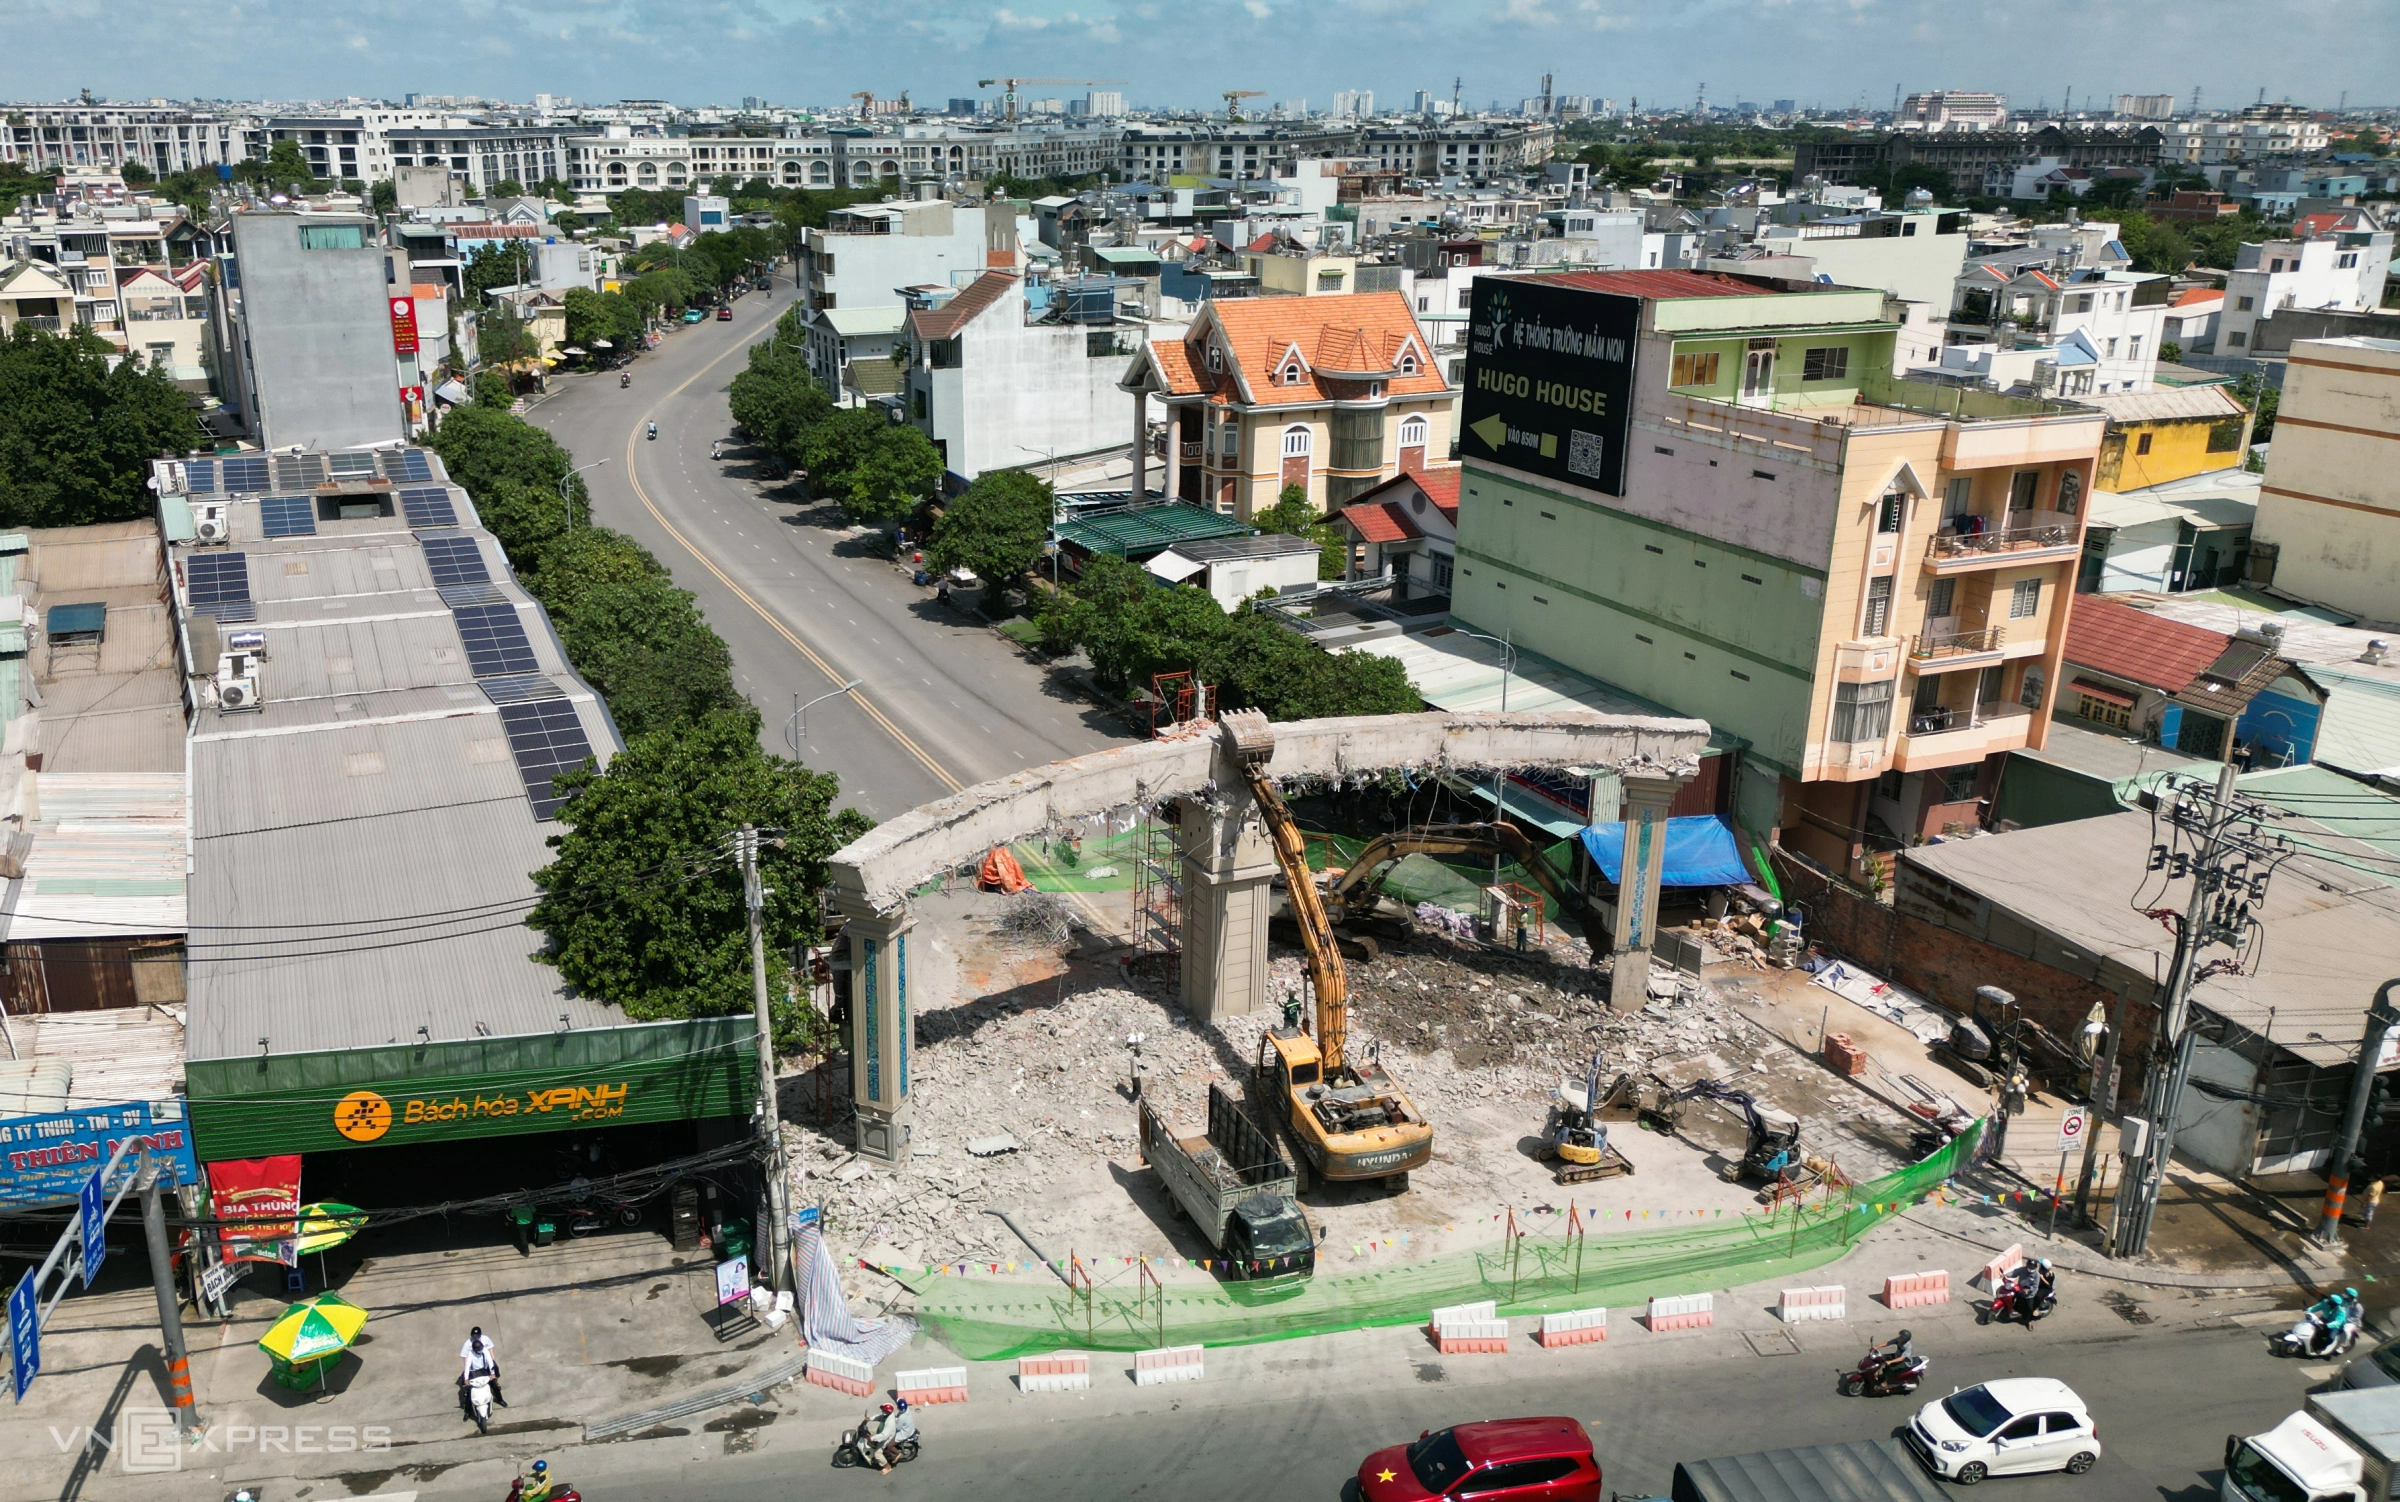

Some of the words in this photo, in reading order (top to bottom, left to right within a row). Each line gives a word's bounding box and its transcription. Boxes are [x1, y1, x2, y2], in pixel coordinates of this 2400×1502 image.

[1474, 323, 1491, 337] HUGO
[1473, 341, 1493, 356] HOUSE
[1605, 337, 1625, 363] NON
[1477, 367, 1529, 398] HUGO
[1536, 379, 1608, 416] HOUSE
[403, 1094, 468, 1124] Bách
[473, 1093, 519, 1117] hóa
[524, 1083, 628, 1113] XANH
[2067, 1107, 2083, 1116] ZONE
[14, 1124, 31, 1141] TY
[35, 1118, 75, 1139] TNHH
[87, 1114, 110, 1132] TM
[122, 1109, 141, 1128] DV
[8, 1140, 99, 1171] THIÊN
[223, 1204, 249, 1214] BIA
[2301, 1428, 2329, 1451] ISUZU
